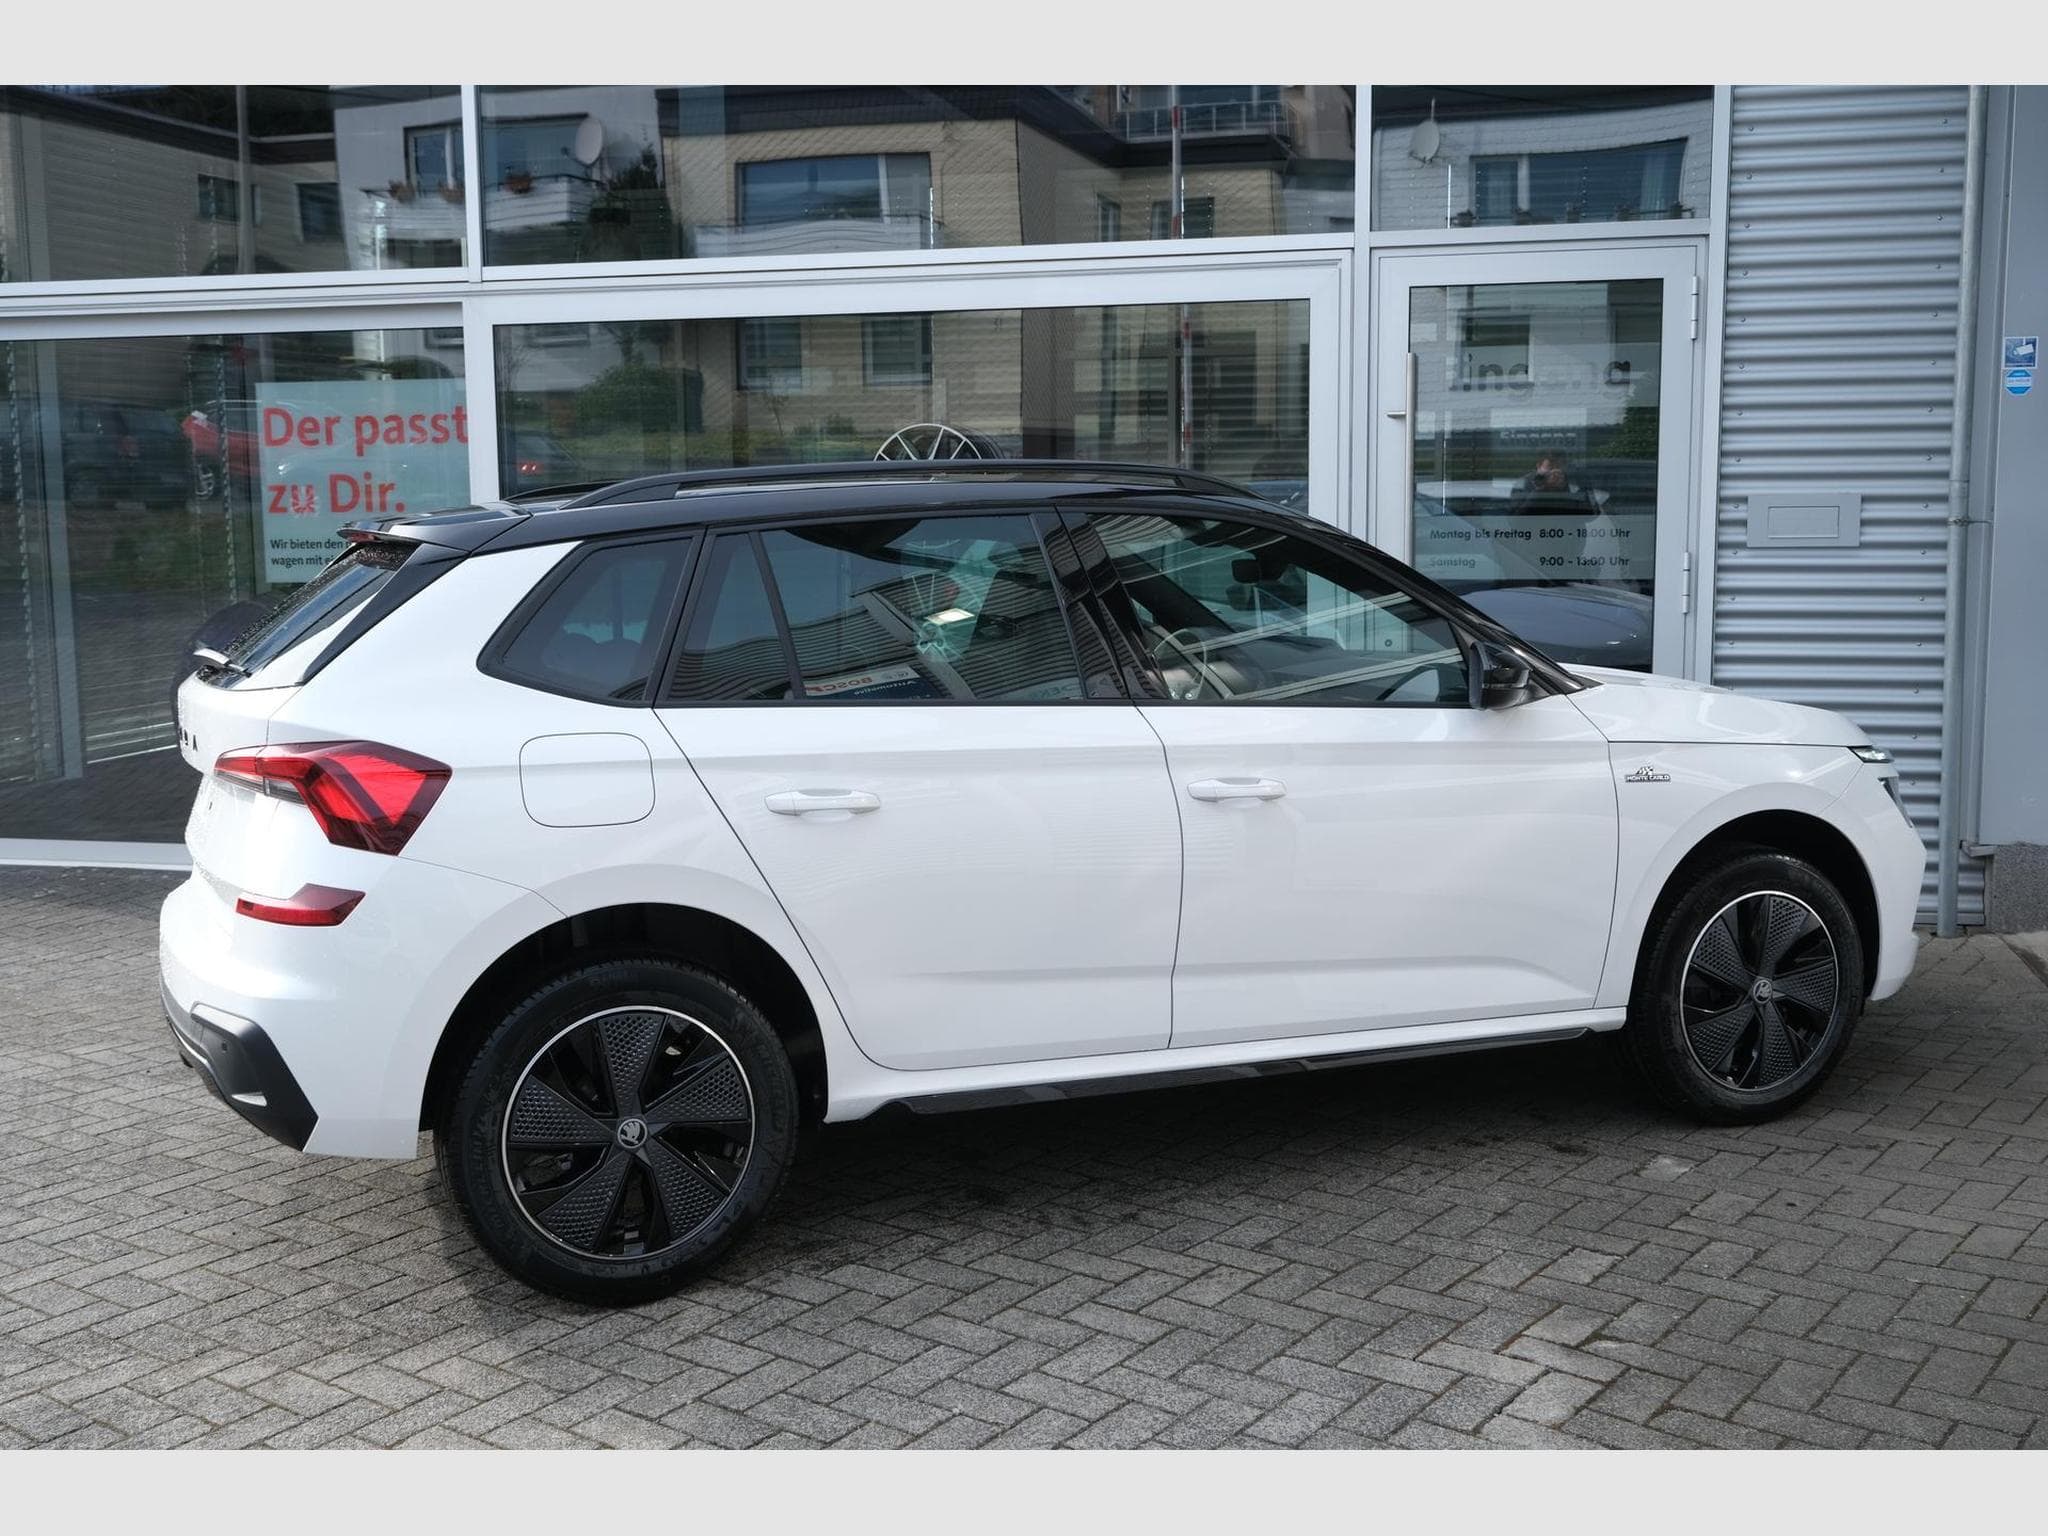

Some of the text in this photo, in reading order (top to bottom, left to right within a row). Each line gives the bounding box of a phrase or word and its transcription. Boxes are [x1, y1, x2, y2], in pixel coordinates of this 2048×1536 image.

[263, 405, 468, 457] Der passt
[267, 471, 406, 514] zu Dir.
[1430, 529, 1472, 541] Montag
[1475, 528, 1491, 539] bis
[1494, 528, 1532, 541] Freitag
[1539, 528, 1565, 539] 8:00
[1610, 528, 1631, 539] Uhr
[270, 538, 289, 550] Wir
[290, 538, 323, 550] bieten
[324, 538, 344, 550] den
[271, 557, 304, 569] wagen
[305, 555, 323, 566] mit
[1430, 557, 1476, 569] Samstag
[1539, 556, 1565, 567] 9:00
[1610, 555, 1631, 567] Uhr
